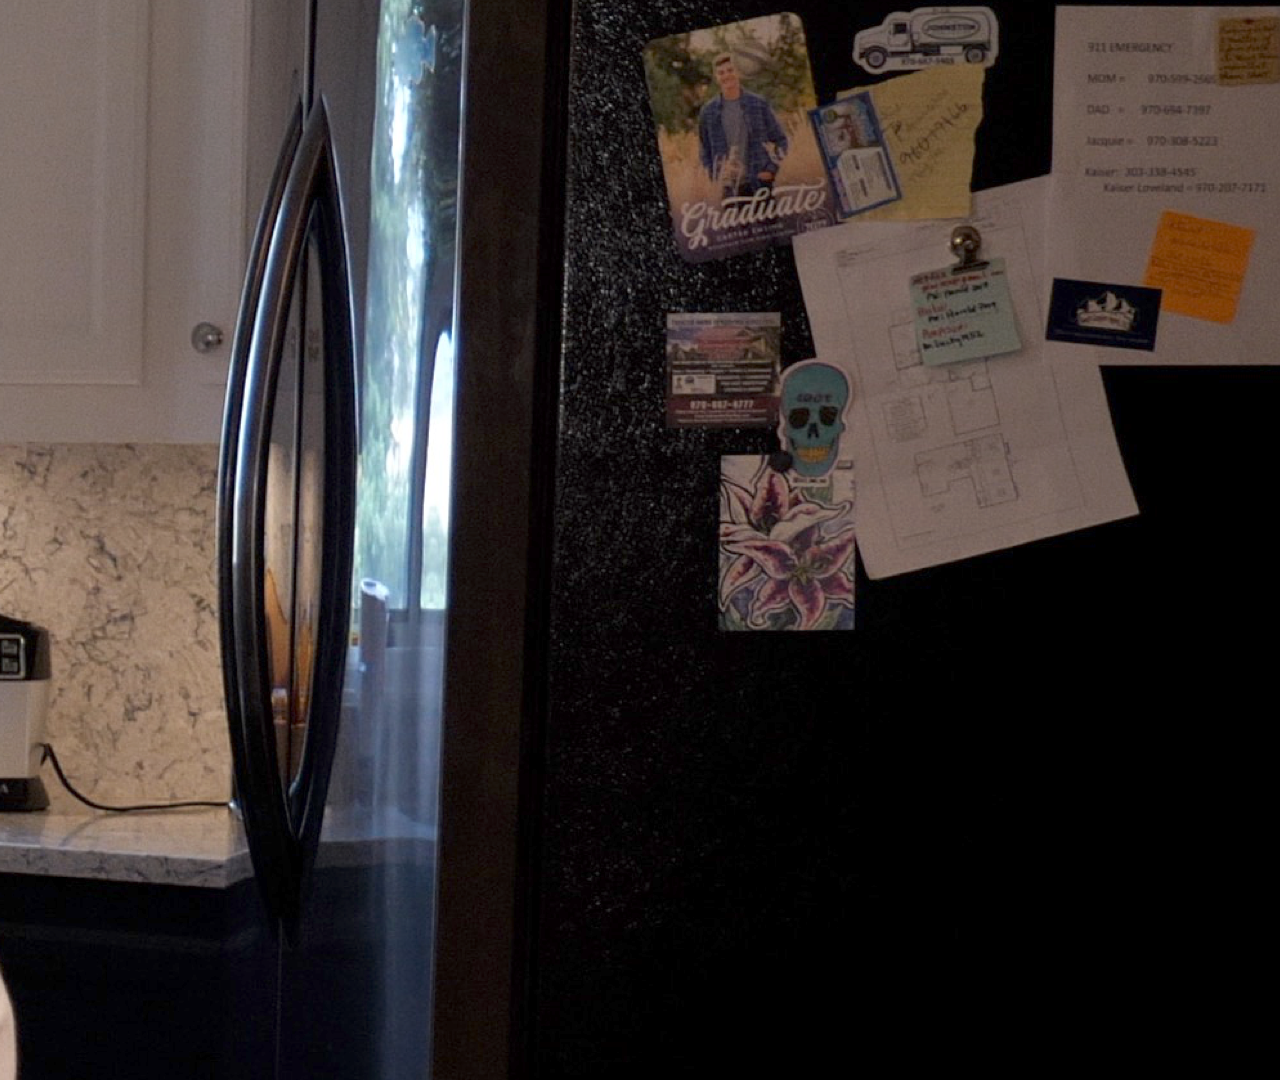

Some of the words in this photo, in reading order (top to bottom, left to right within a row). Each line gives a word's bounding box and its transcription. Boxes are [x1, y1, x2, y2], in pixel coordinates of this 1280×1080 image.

[1087, 43, 1107, 53] 911
[1110, 43, 1174, 53] EMERGENCY
[1087, 74, 1117, 84] MOM
[1086, 105, 1110, 115] DAD
[681, 177, 826, 250] Graduate
